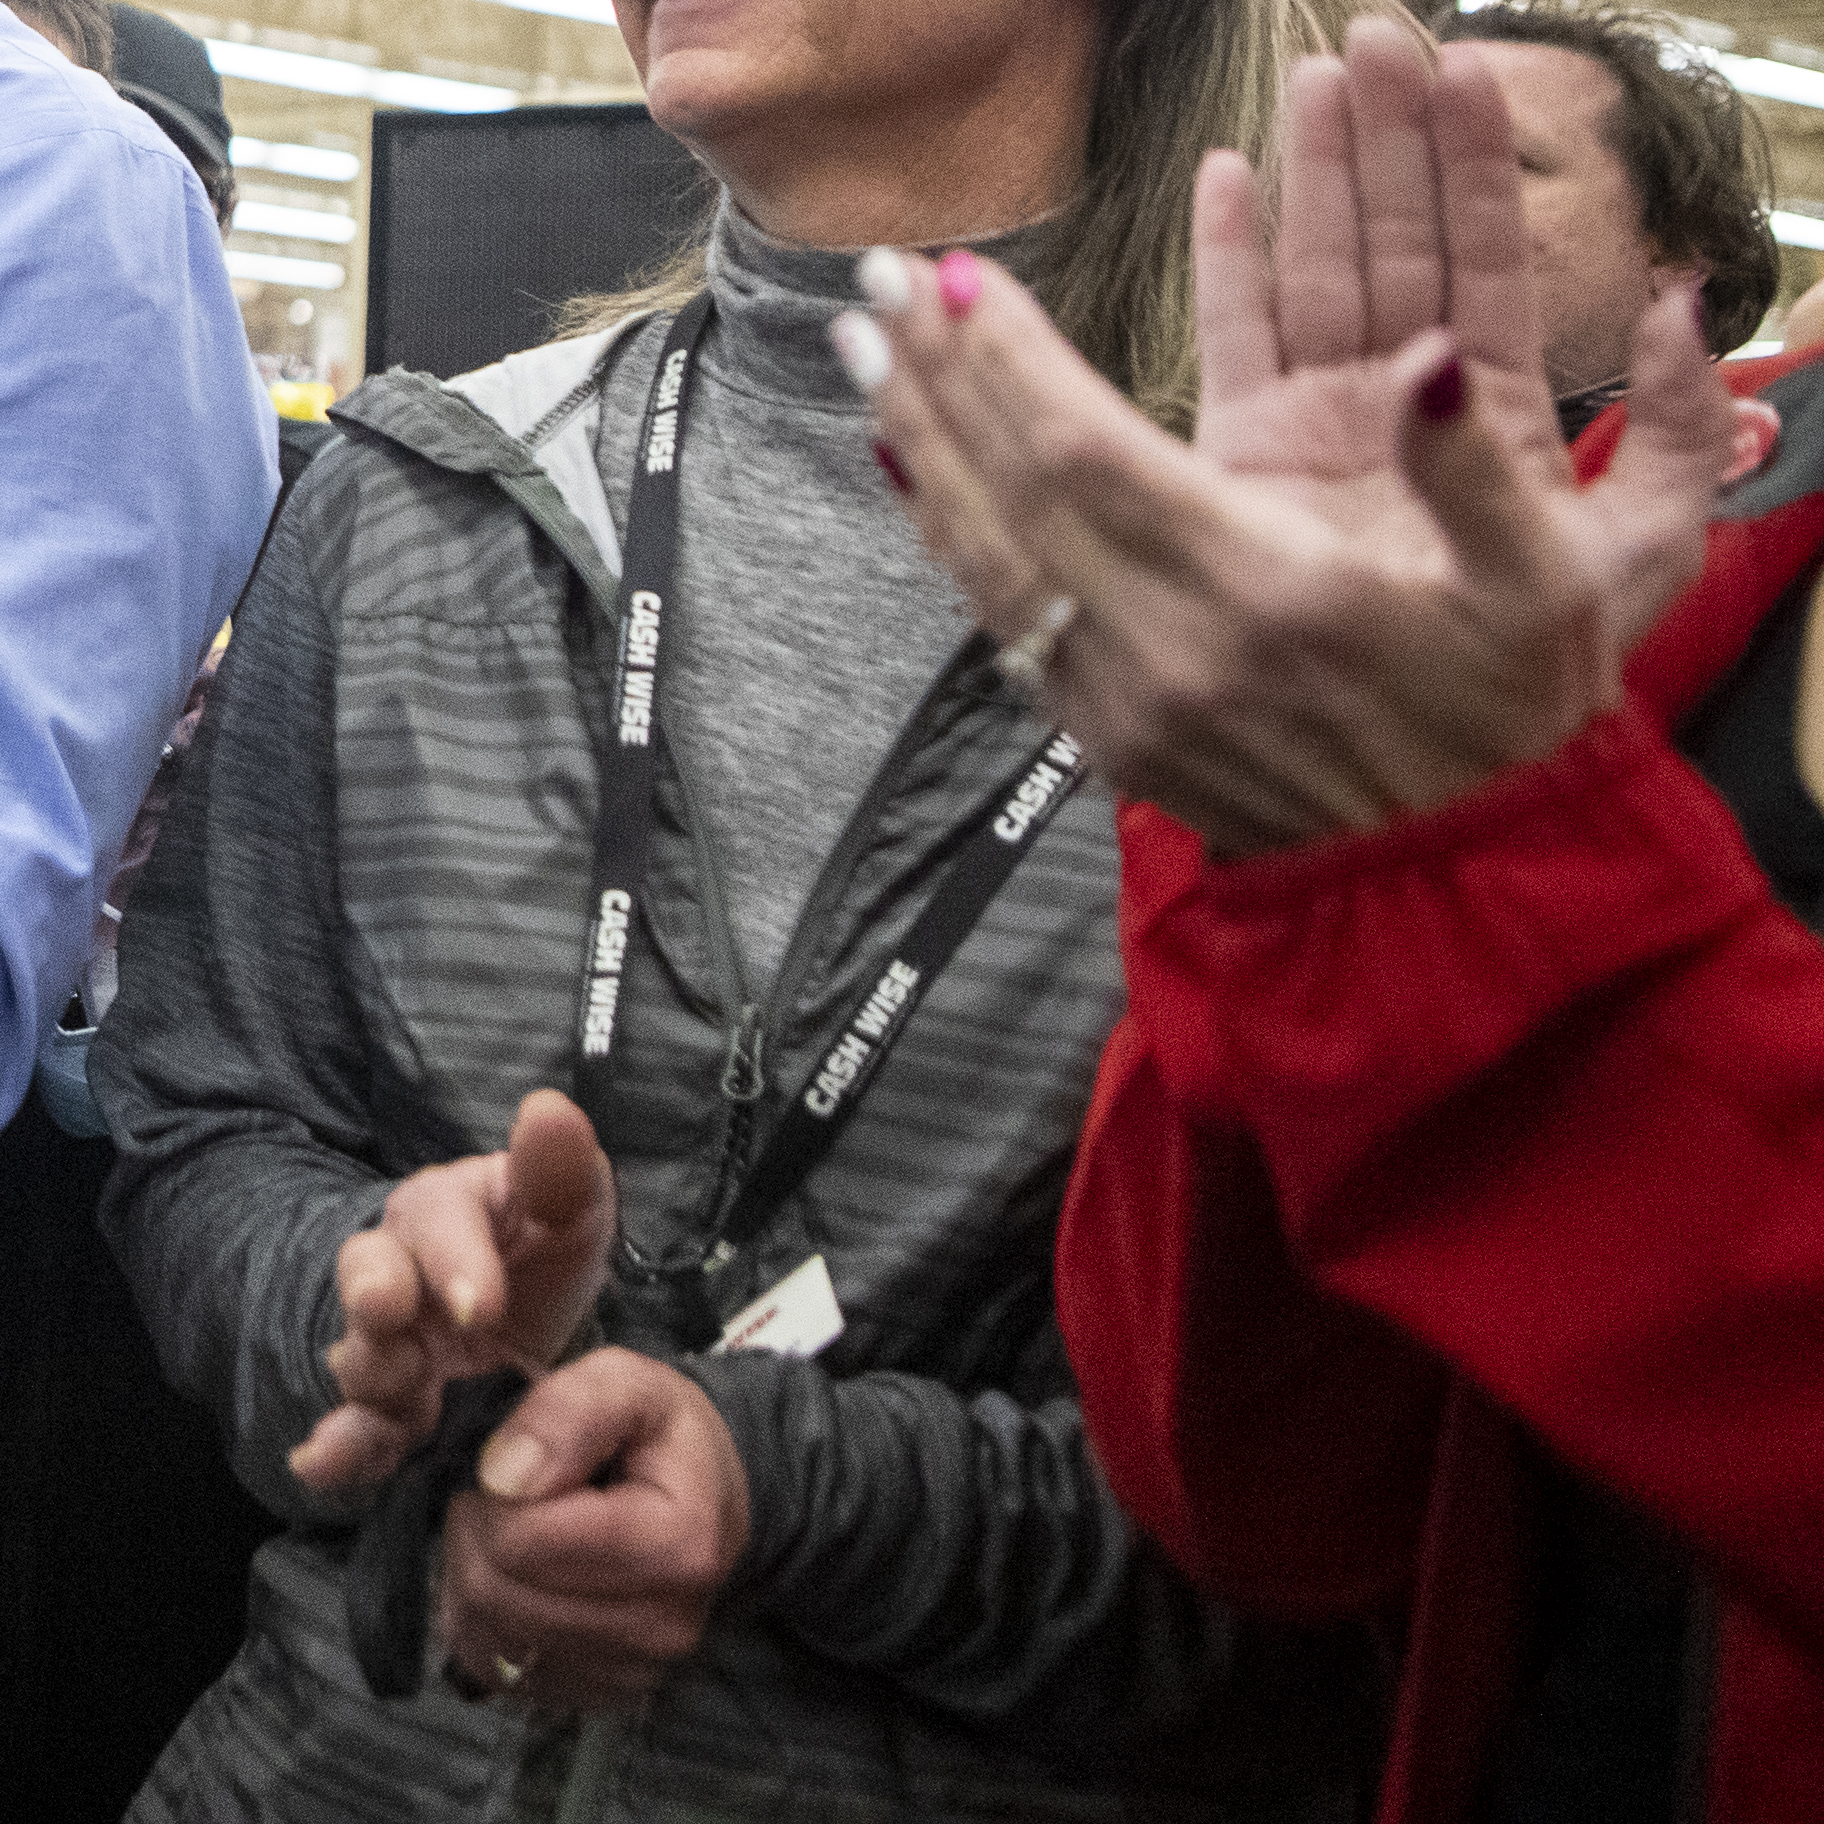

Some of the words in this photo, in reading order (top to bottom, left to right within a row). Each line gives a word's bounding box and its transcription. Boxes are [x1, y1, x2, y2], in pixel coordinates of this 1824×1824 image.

[657, 349, 688, 409] CASH
[647, 410, 679, 473] WISE
[627, 589, 662, 667] CASH
[620, 672, 654, 746] WISE
[993, 762, 1063, 842] CASH
[594, 889, 631, 972] CASH
[583, 977, 619, 1056] WISE
[804, 1032, 870, 1117] CASH
[854, 959, 920, 1036] WISE
